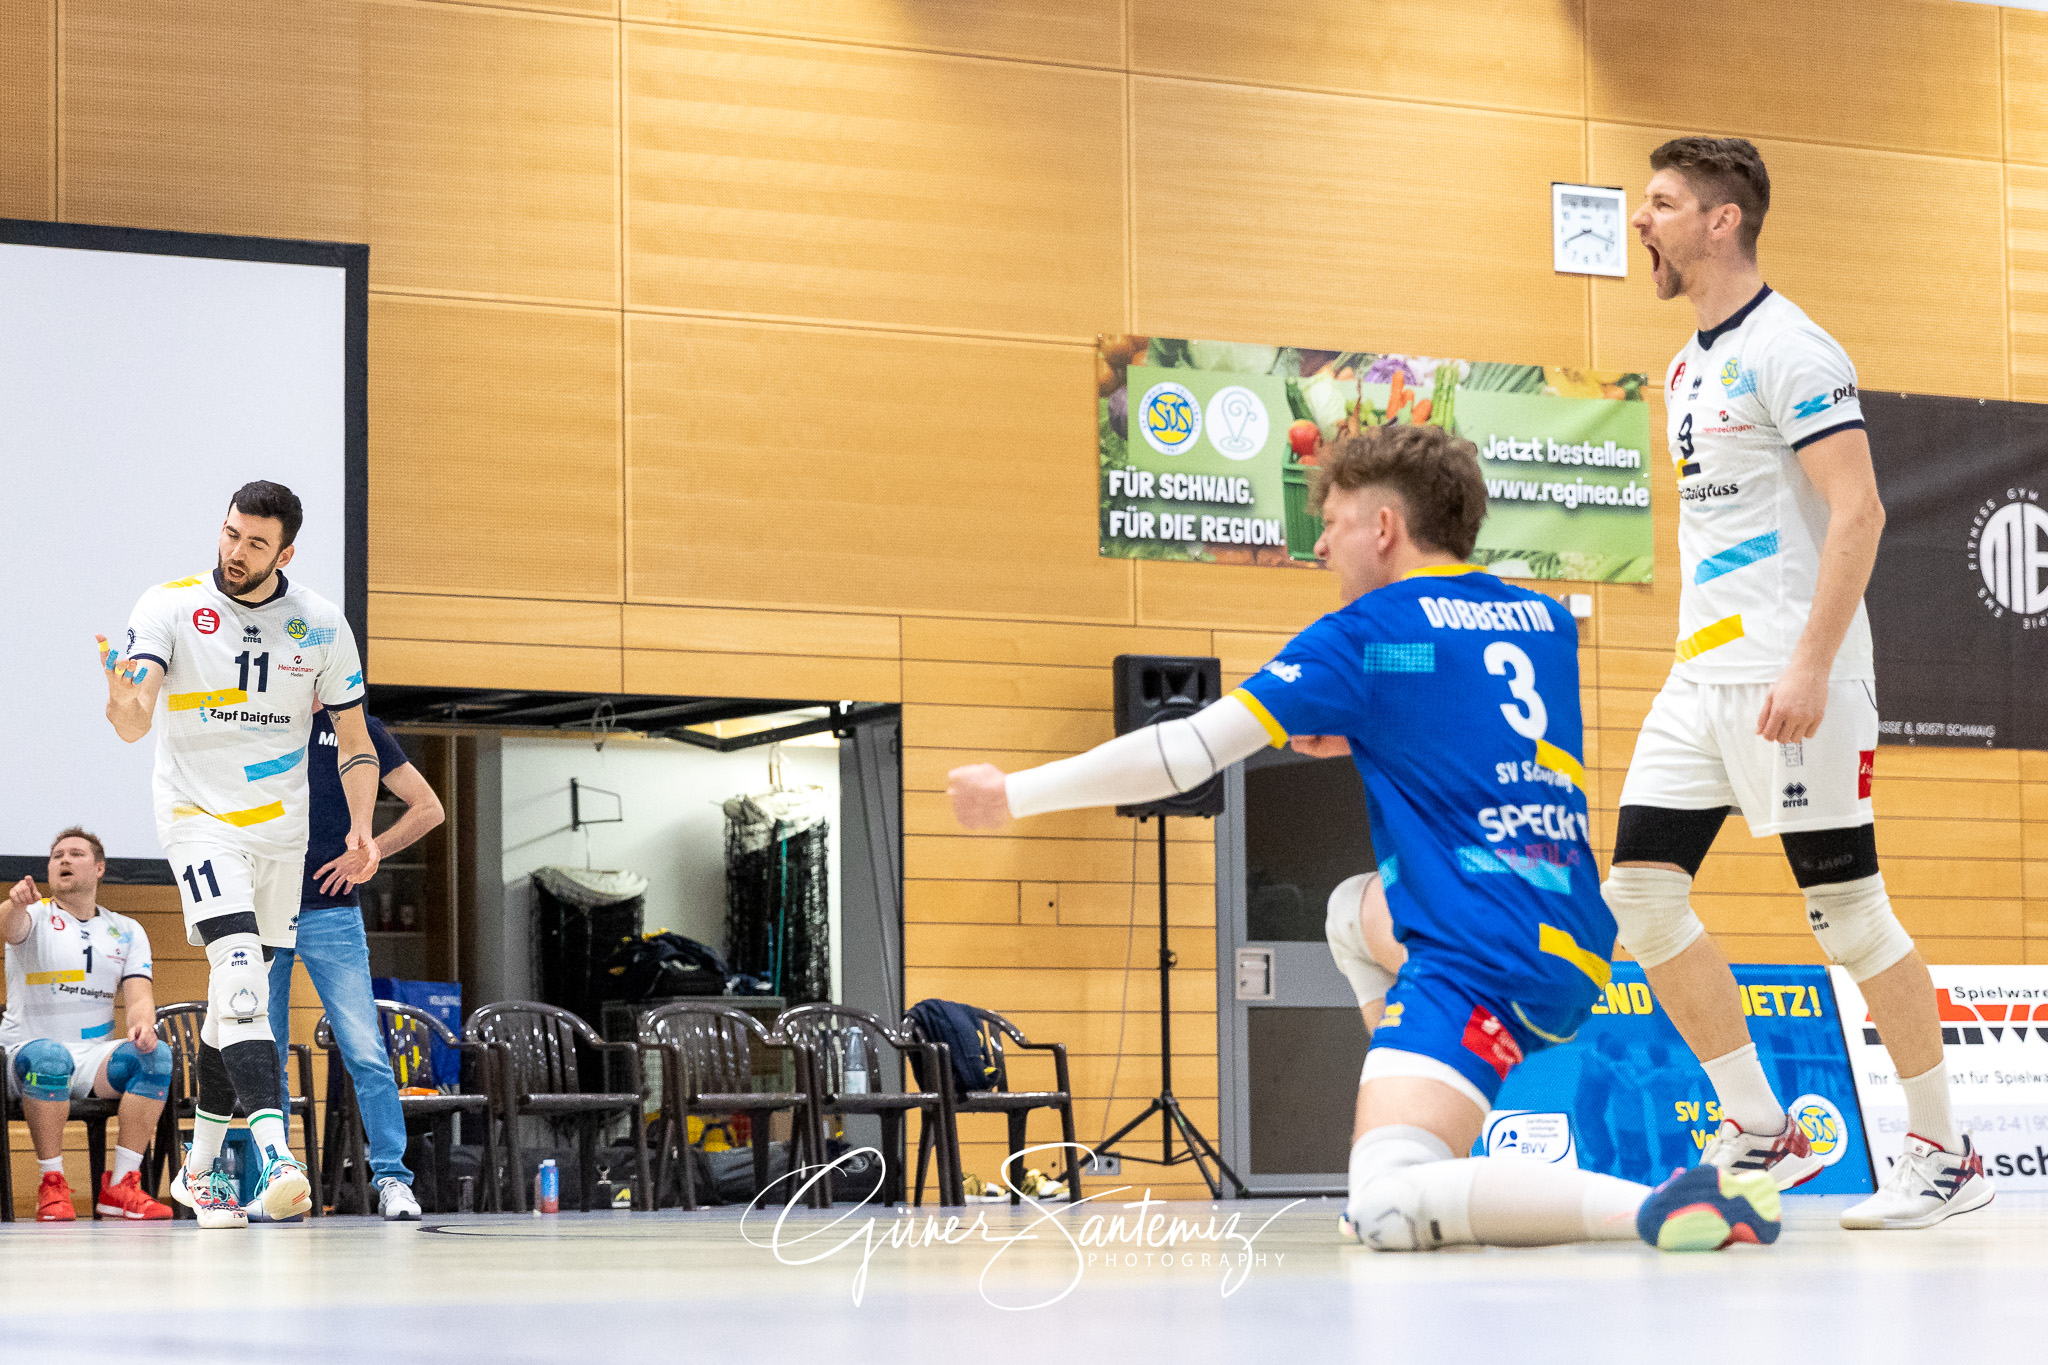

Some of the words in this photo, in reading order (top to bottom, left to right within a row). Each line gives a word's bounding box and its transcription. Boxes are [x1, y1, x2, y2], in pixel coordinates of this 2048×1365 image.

[1482, 433, 1544, 462] Jetzt
[1547, 436, 1640, 469] bestellen
[1109, 465, 1155, 498] FÜR
[1158, 473, 1255, 505] SCHWAIG.
[1485, 476, 1650, 510] www.regineo.de
[1109, 505, 1156, 539] FÜR
[1159, 512, 1197, 542] DIE
[1200, 514, 1286, 547] REGION.
[1418, 597, 1555, 632] DOBBERTIN
[235, 651, 269, 692] 11
[1484, 641, 1547, 740] 3
[209, 708, 239, 722] Zapf
[240, 711, 291, 725] Daigfuss
[1495, 761, 1519, 785] SV
[183, 859, 221, 904] 11
[83, 946, 92, 973] 1
[1675, 1101, 1699, 1121] SV
[1521, 1142, 1547, 1154] BVV
